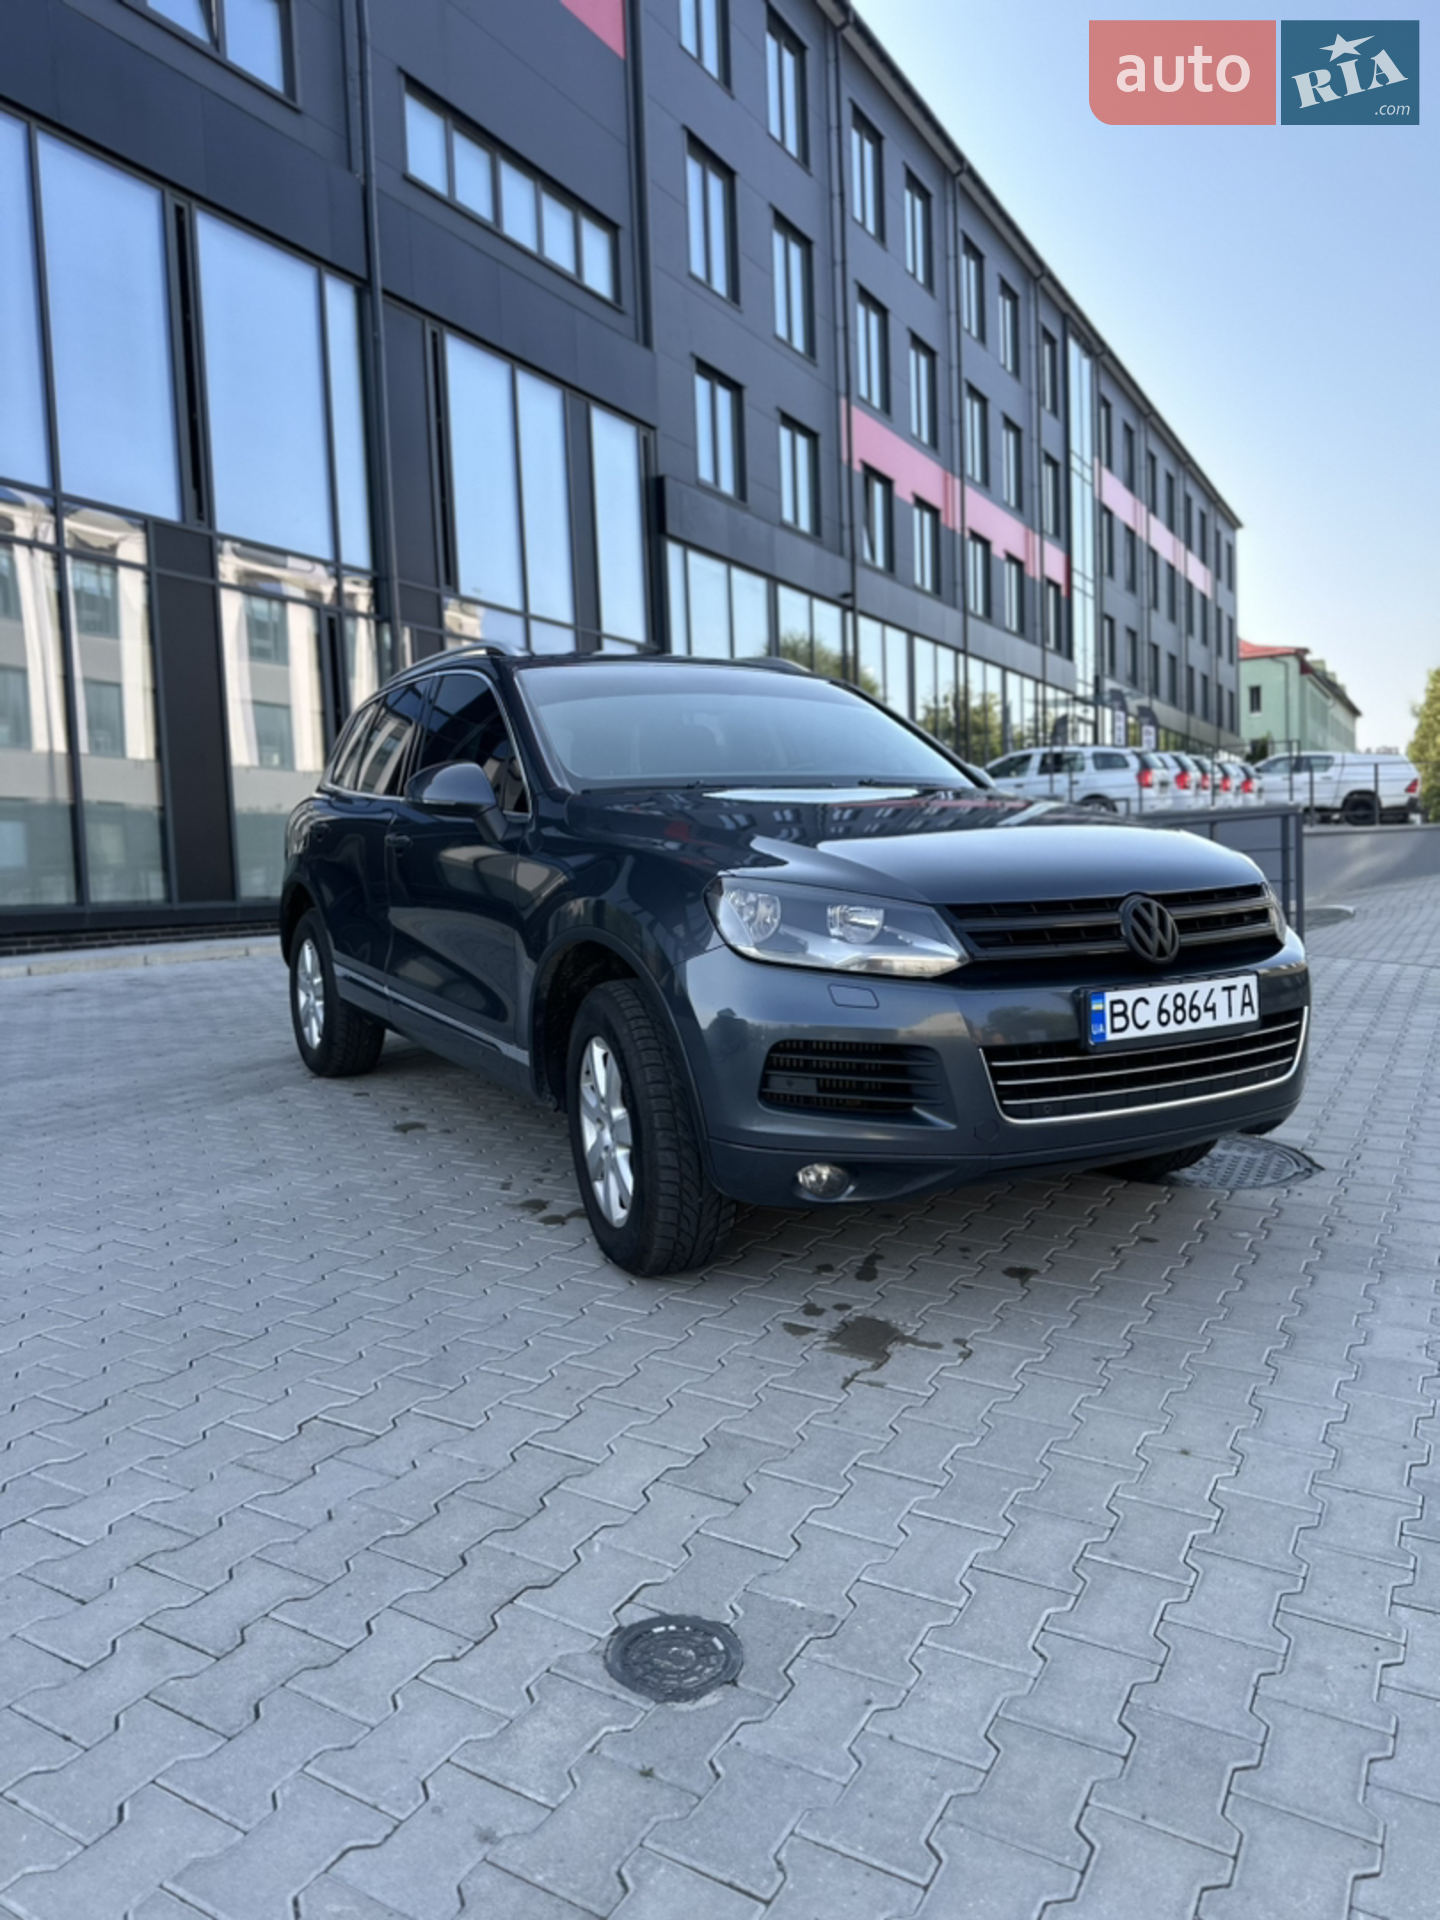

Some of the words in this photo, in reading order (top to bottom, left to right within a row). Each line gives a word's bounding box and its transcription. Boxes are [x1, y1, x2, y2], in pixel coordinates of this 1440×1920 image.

[1109, 996, 1151, 1034] BC
[1156, 987, 1218, 1028] 6864
[1221, 982, 1256, 1018] TA
